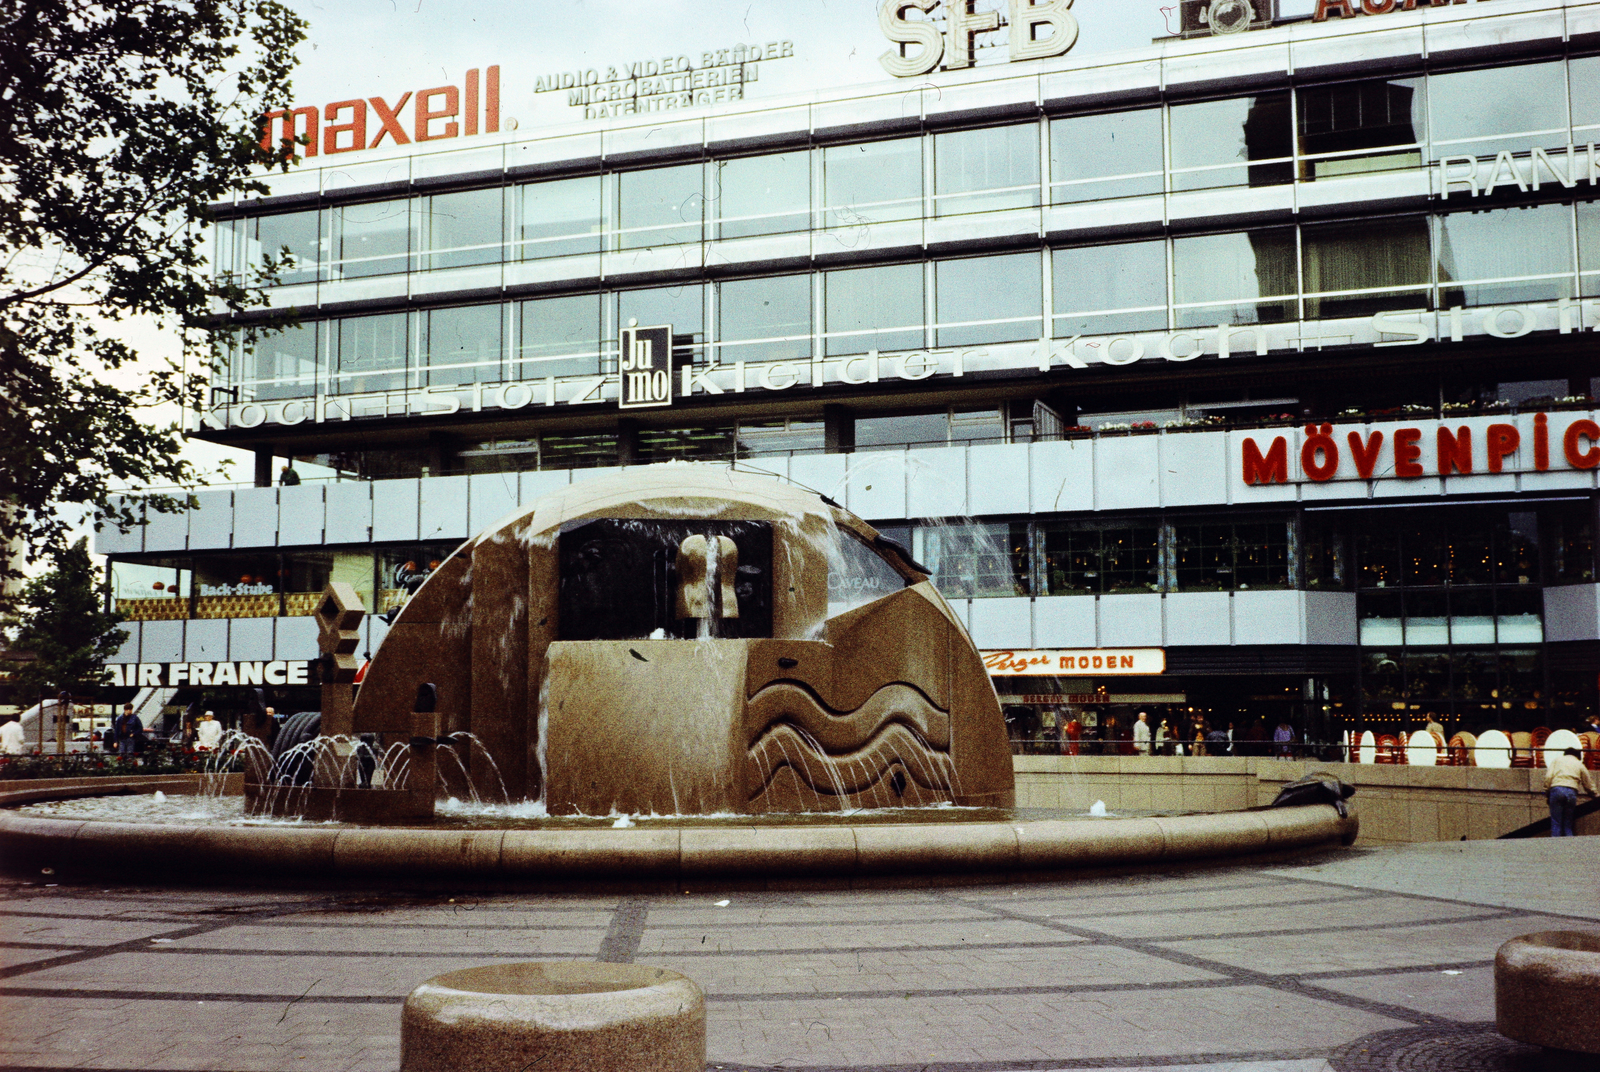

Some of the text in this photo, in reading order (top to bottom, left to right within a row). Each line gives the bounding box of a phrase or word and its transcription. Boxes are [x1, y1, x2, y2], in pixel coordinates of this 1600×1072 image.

[534, 39, 794, 93] AUDIO & VIDEO BÄNDER
[568, 63, 759, 107] MICROBATTERIEN
[260, 65, 500, 162] maxell
[584, 84, 744, 120] DATENTRÄGER
[1371, 297, 1600, 348] Stol
[200, 581, 274, 597] Back-Stube
[100, 660, 309, 687] AIR FRANCE
[1059, 655, 1134, 669] MODEN
